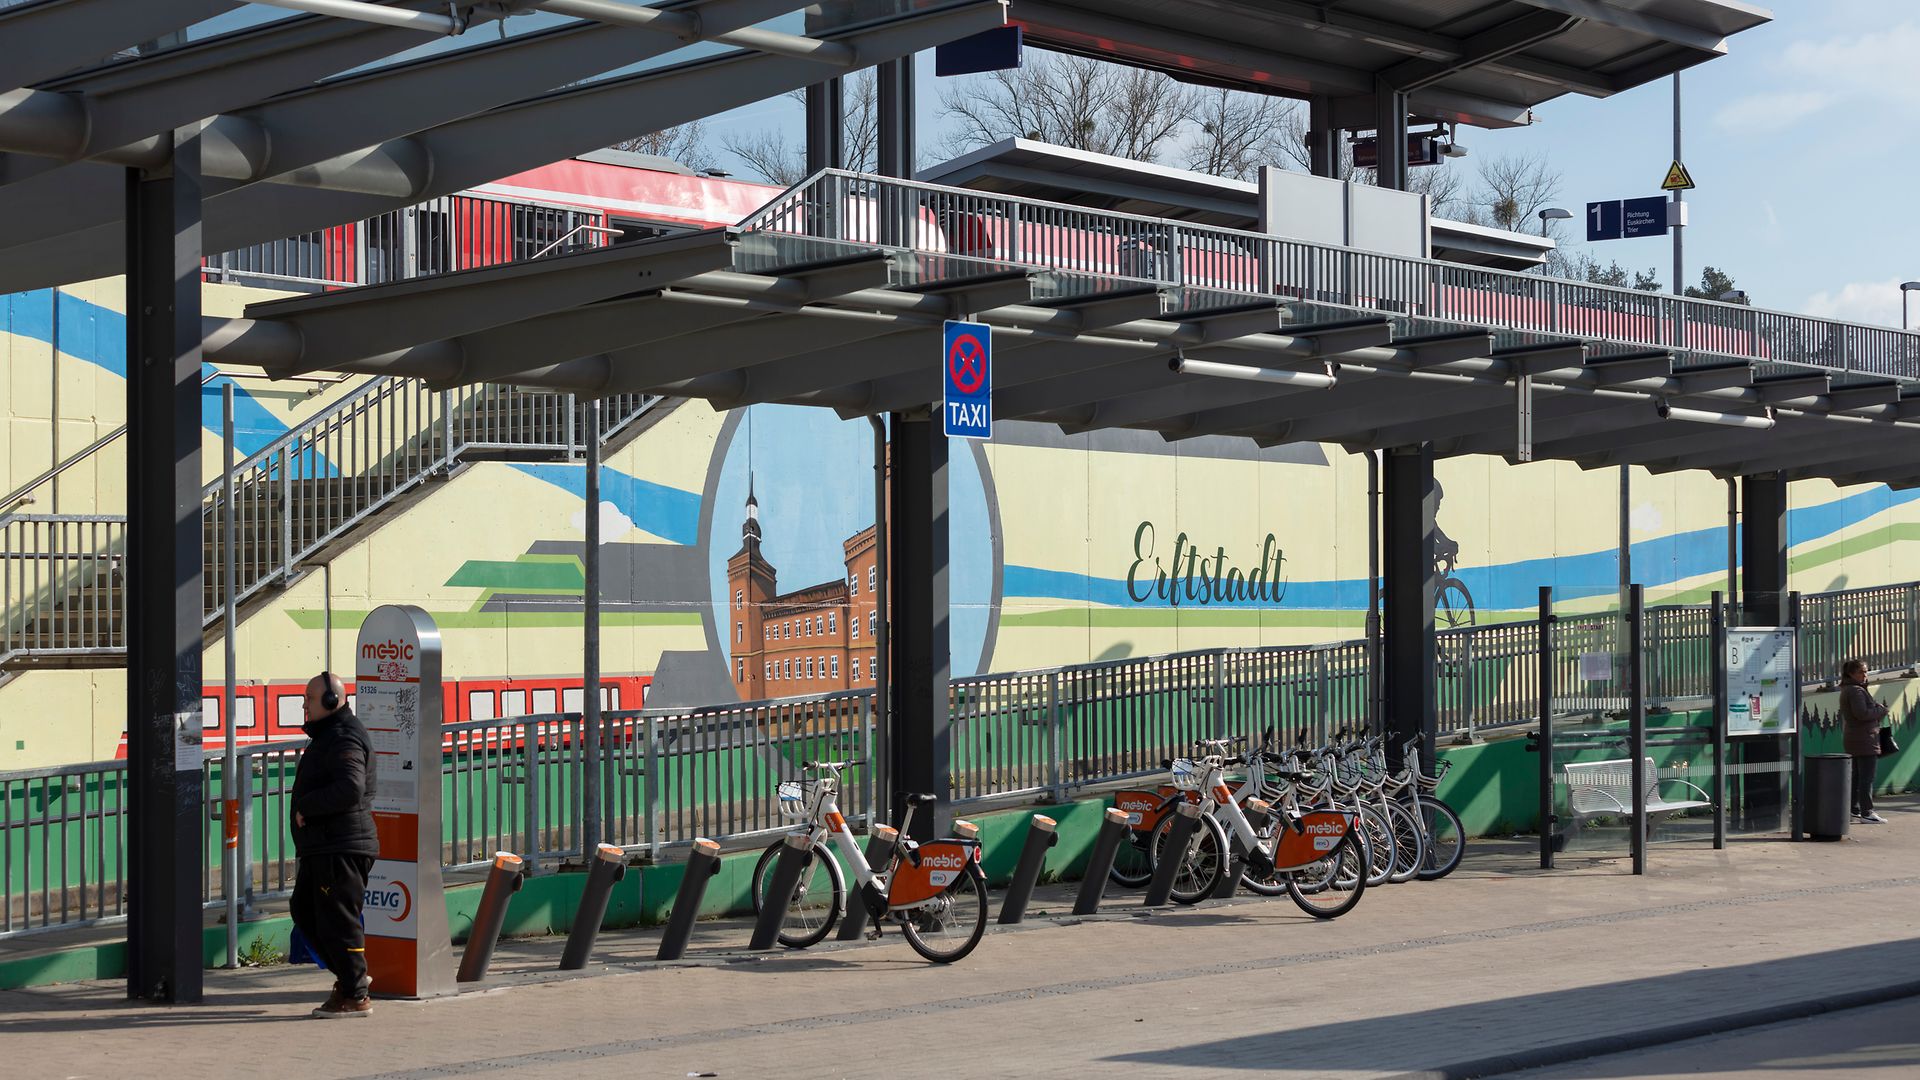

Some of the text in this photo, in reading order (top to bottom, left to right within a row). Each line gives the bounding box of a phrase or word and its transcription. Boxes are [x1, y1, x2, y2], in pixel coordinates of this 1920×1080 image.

[1591, 204, 1601, 231] 1
[1627, 218, 1655, 226] Euskirchen
[949, 402, 986, 428] TAXI
[1127, 520, 1288, 606] Erftstadt
[360, 686, 377, 694] 51326
